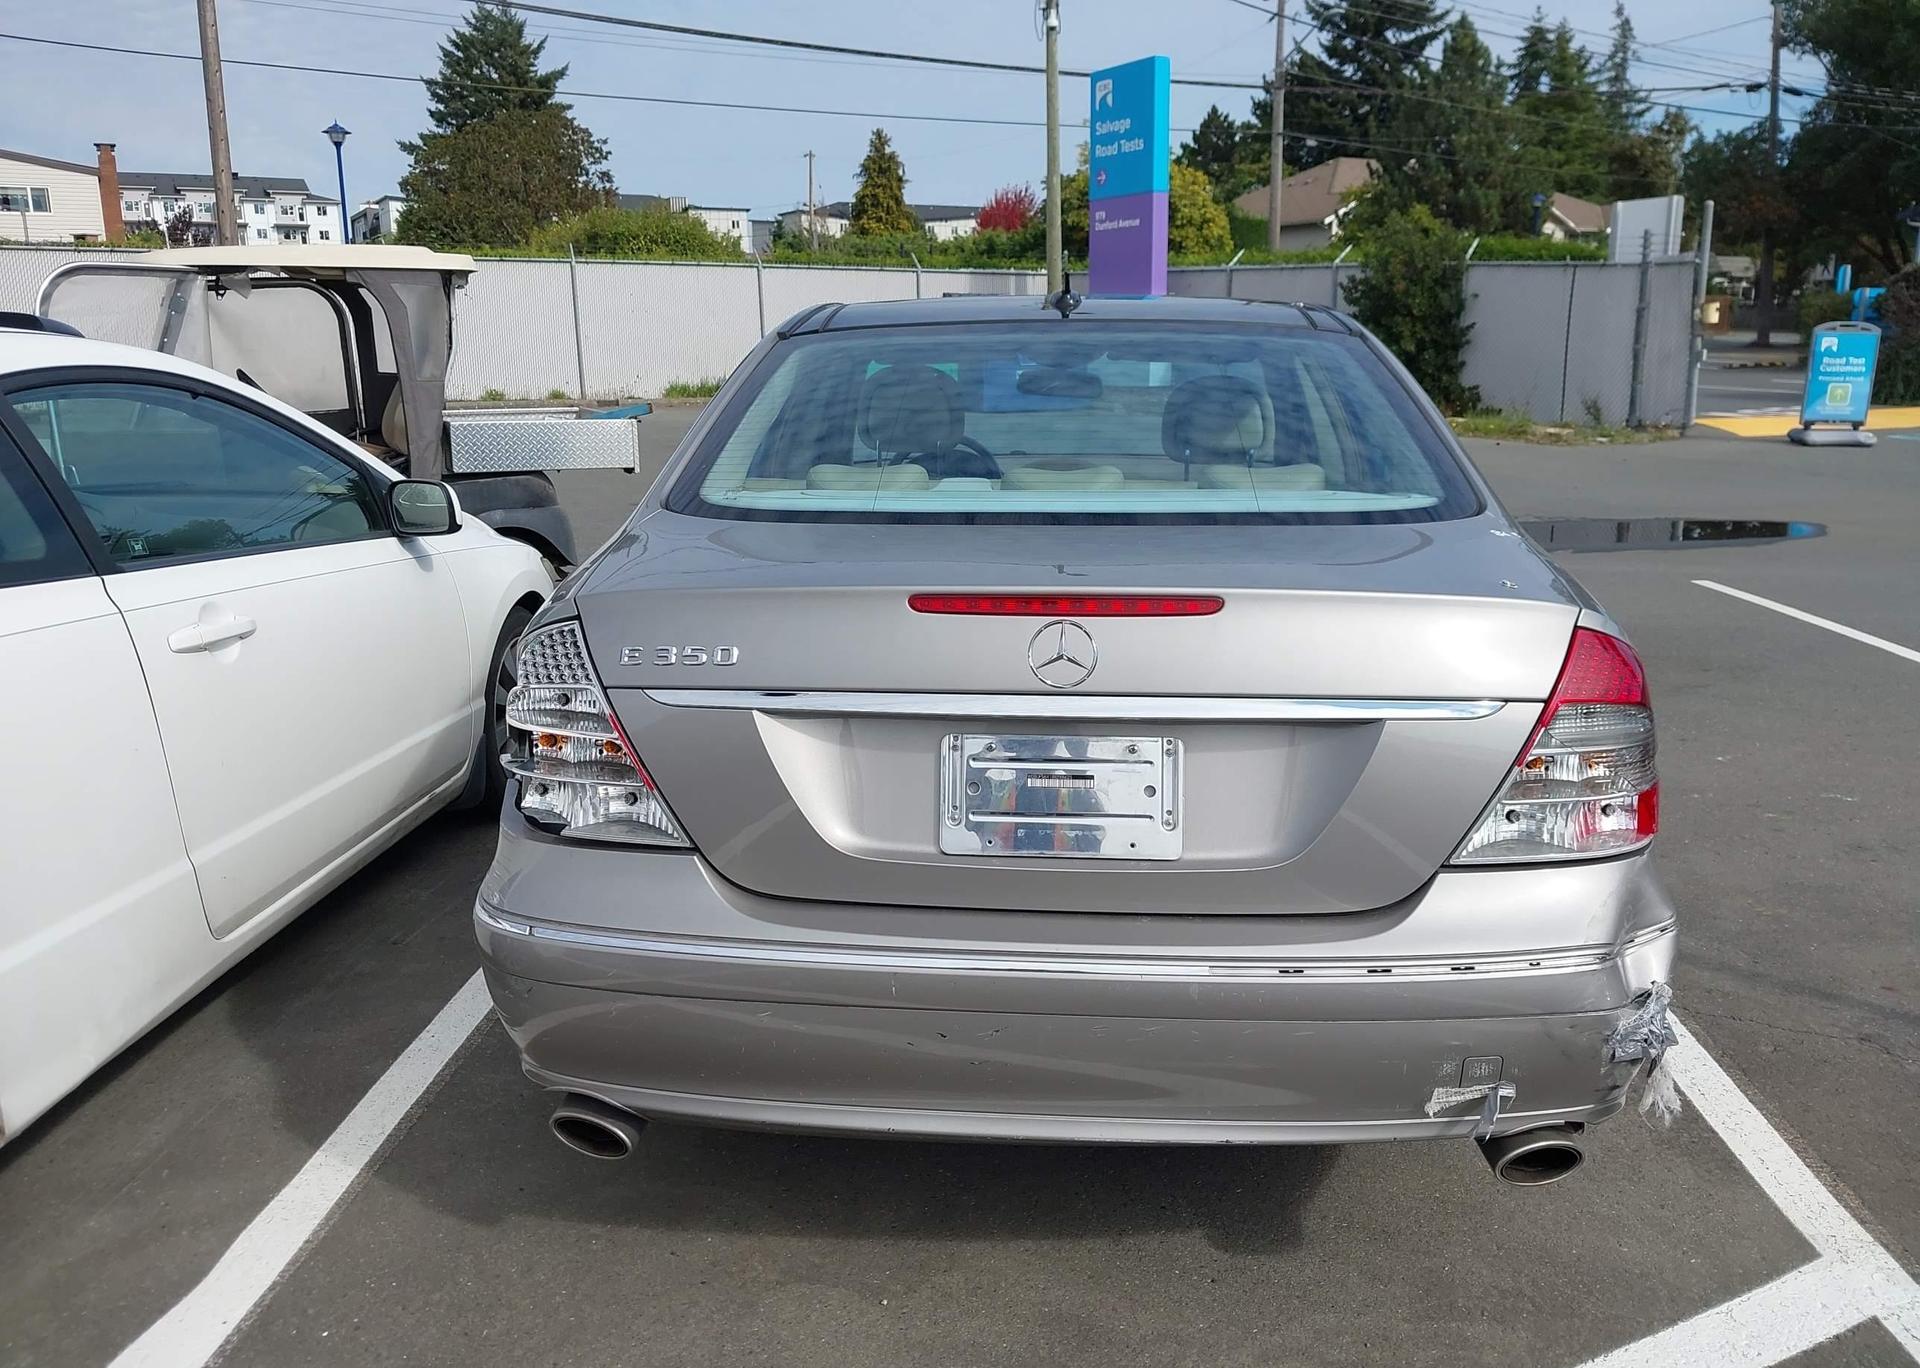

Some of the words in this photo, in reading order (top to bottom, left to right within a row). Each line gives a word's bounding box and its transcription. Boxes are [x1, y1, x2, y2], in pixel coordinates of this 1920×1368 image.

[1095, 117, 1131, 136] Salvage
[1095, 141, 1118, 158] Road
[1119, 137, 1145, 153] Tests
[1823, 356, 1846, 365] Road
[1848, 356, 1866, 365] Test
[620, 646, 643, 666] E
[653, 646, 739, 666] 350
